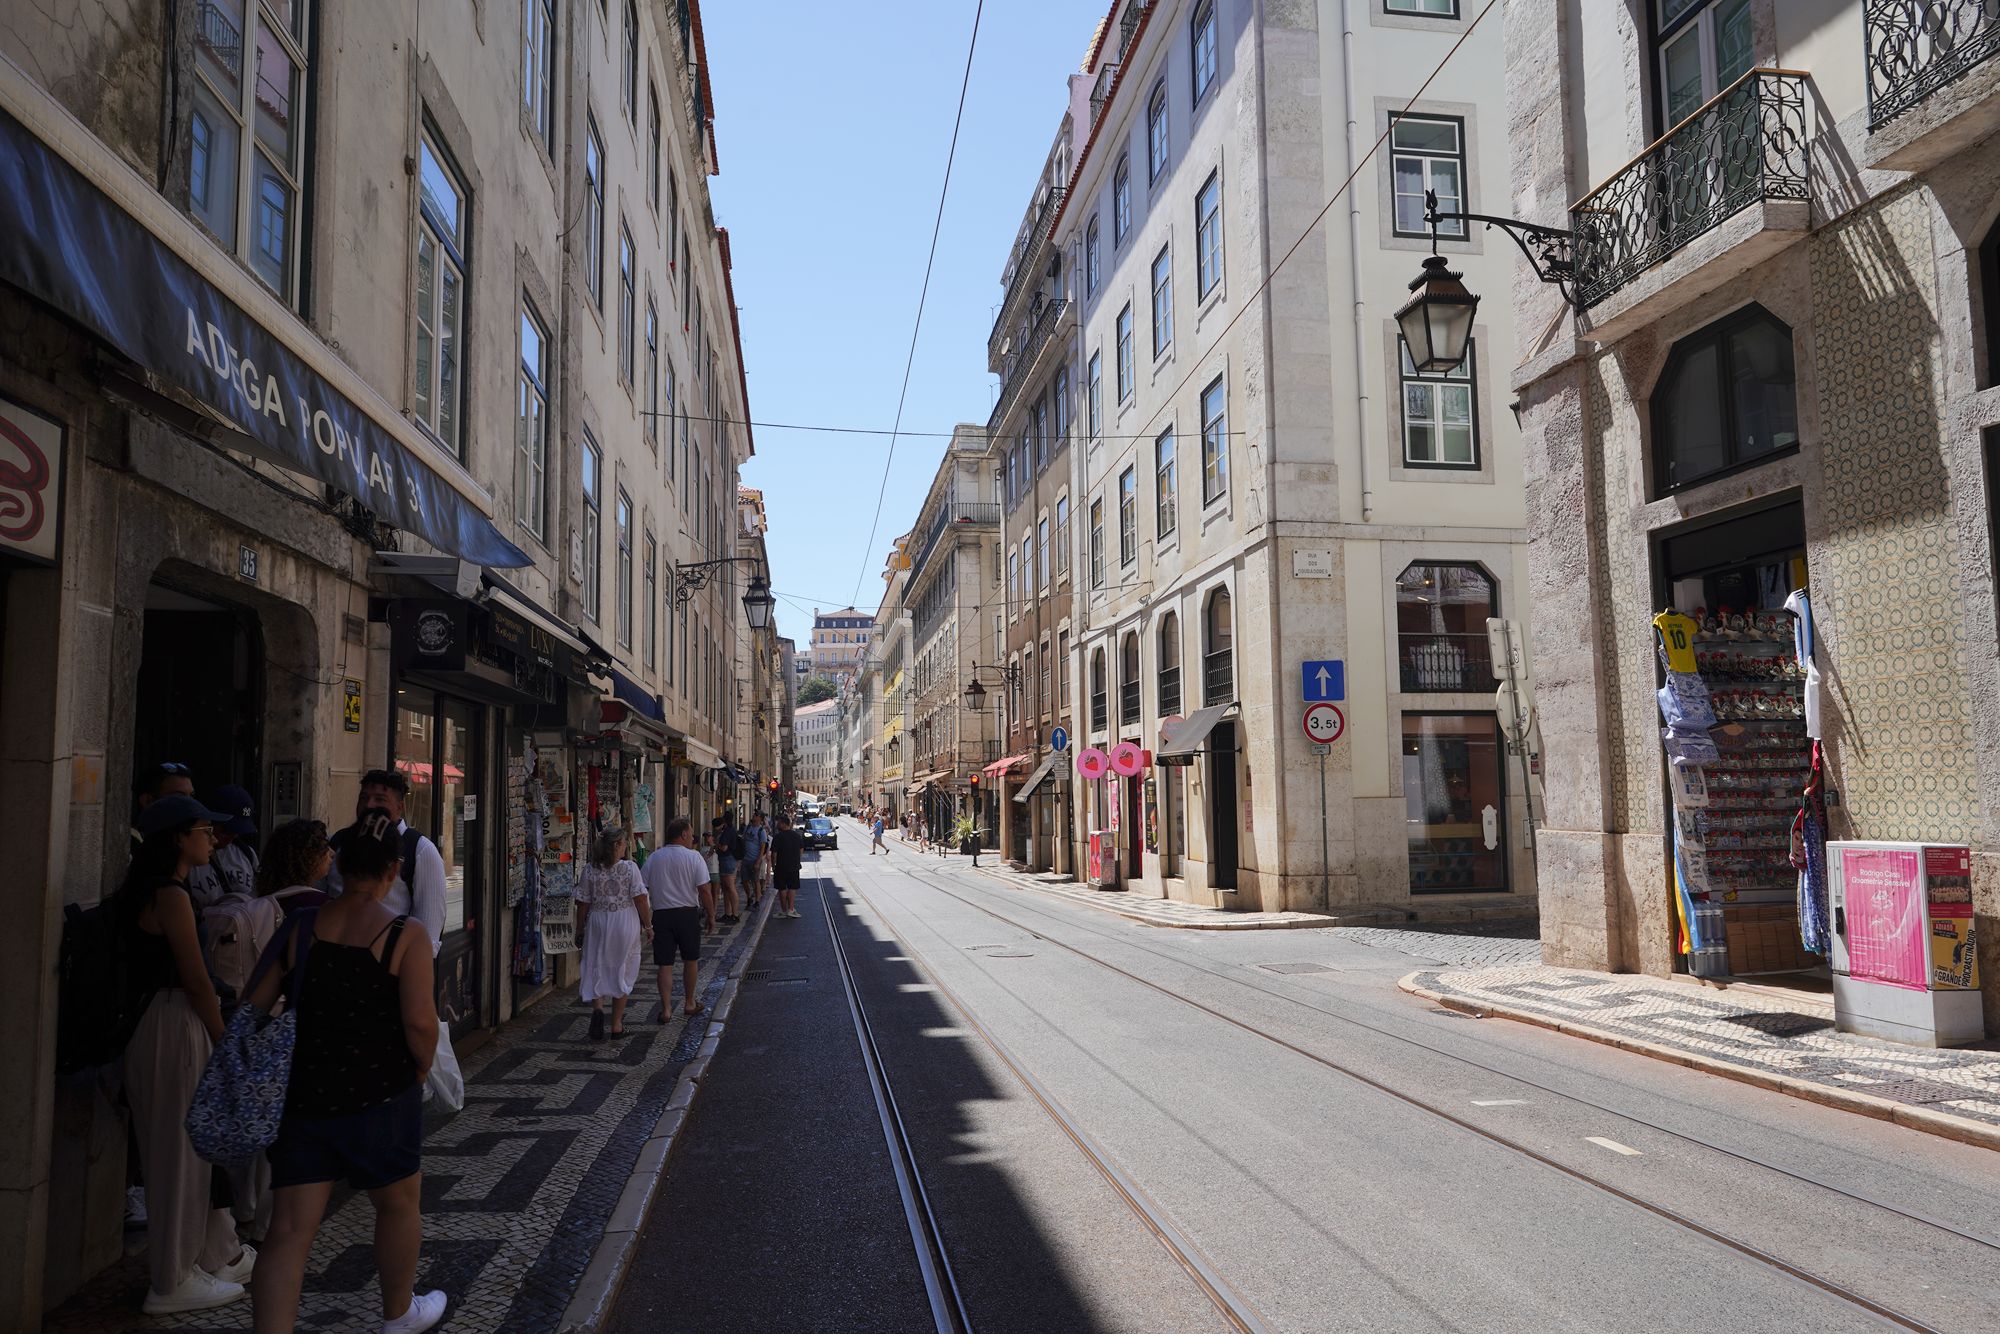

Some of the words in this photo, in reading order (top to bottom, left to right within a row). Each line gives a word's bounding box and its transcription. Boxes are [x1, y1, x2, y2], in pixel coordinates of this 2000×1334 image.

[186, 308, 287, 426] ADEGA
[243, 550, 255, 576] 35
[1669, 629, 1687, 650] 10
[1310, 716, 1337, 730] 3,5t
[1859, 868, 1884, 878] Rodrigo
[547, 940, 574, 950] LISBOA
[1961, 929, 1976, 987] PROCRASTINADOR
[1937, 971, 1962, 986] GRANDE
